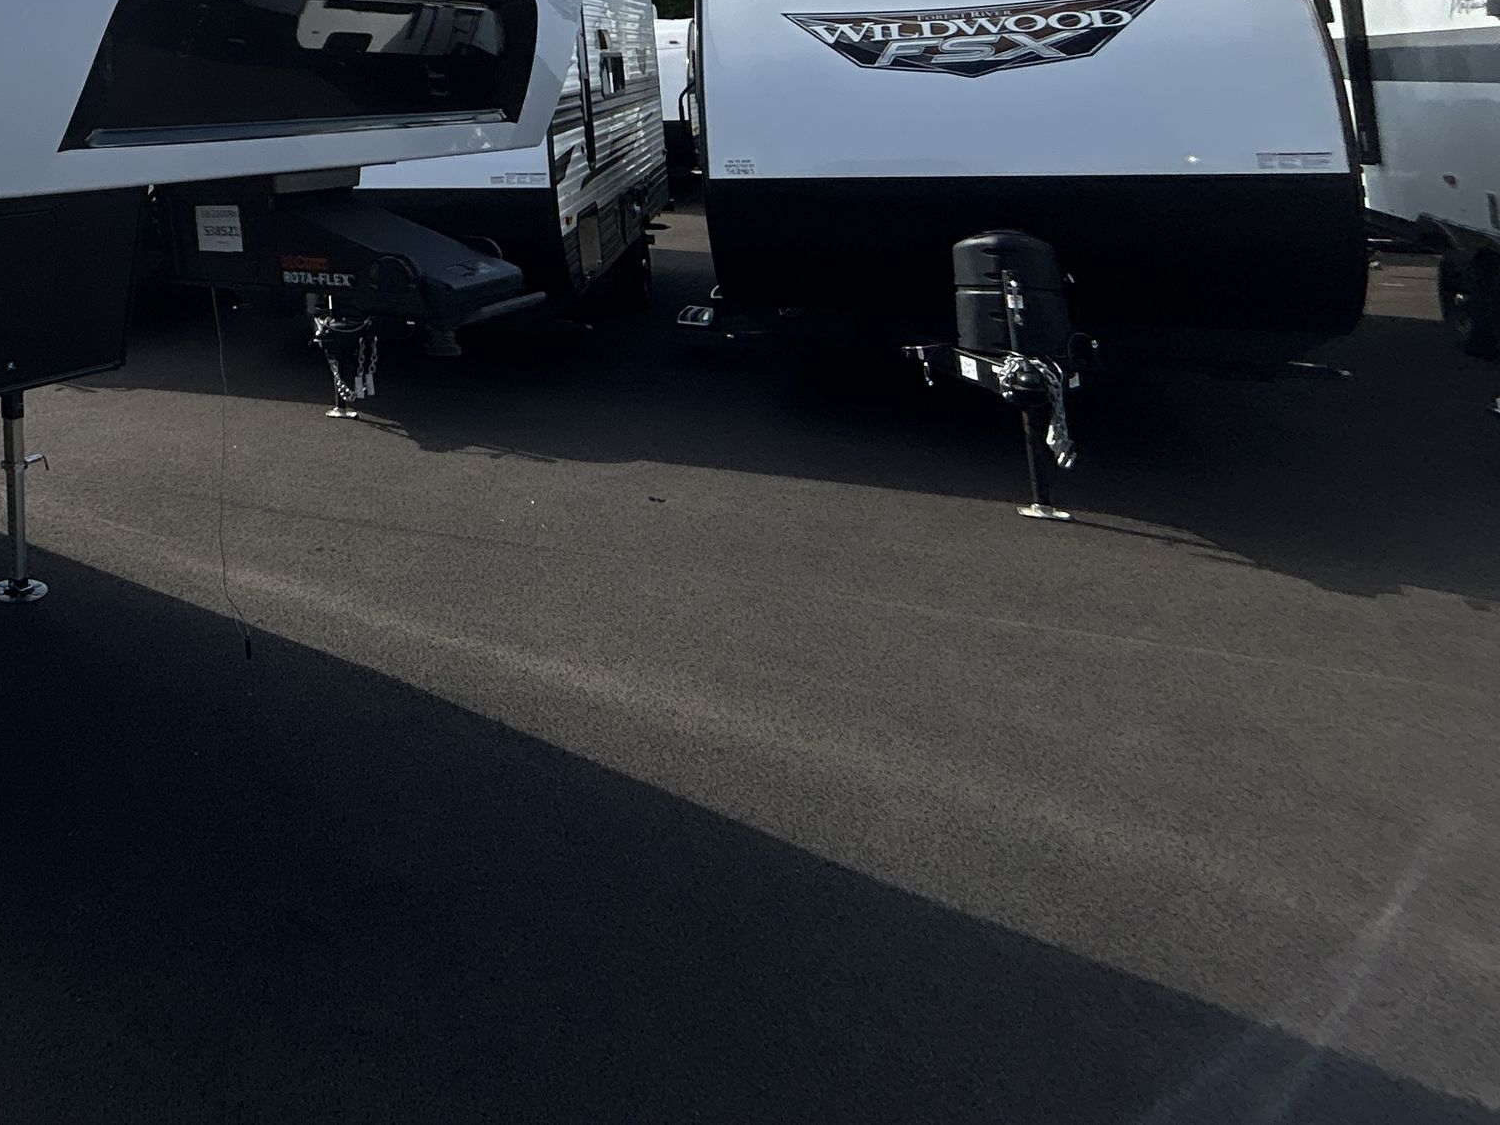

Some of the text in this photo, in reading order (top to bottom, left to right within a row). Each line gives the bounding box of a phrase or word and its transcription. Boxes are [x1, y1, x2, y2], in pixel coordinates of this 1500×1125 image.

[809, 9, 1133, 44] WILDWOOD
[917, 8, 1012, 22] FOREST RIVER
[873, 28, 1091, 67] FSX
